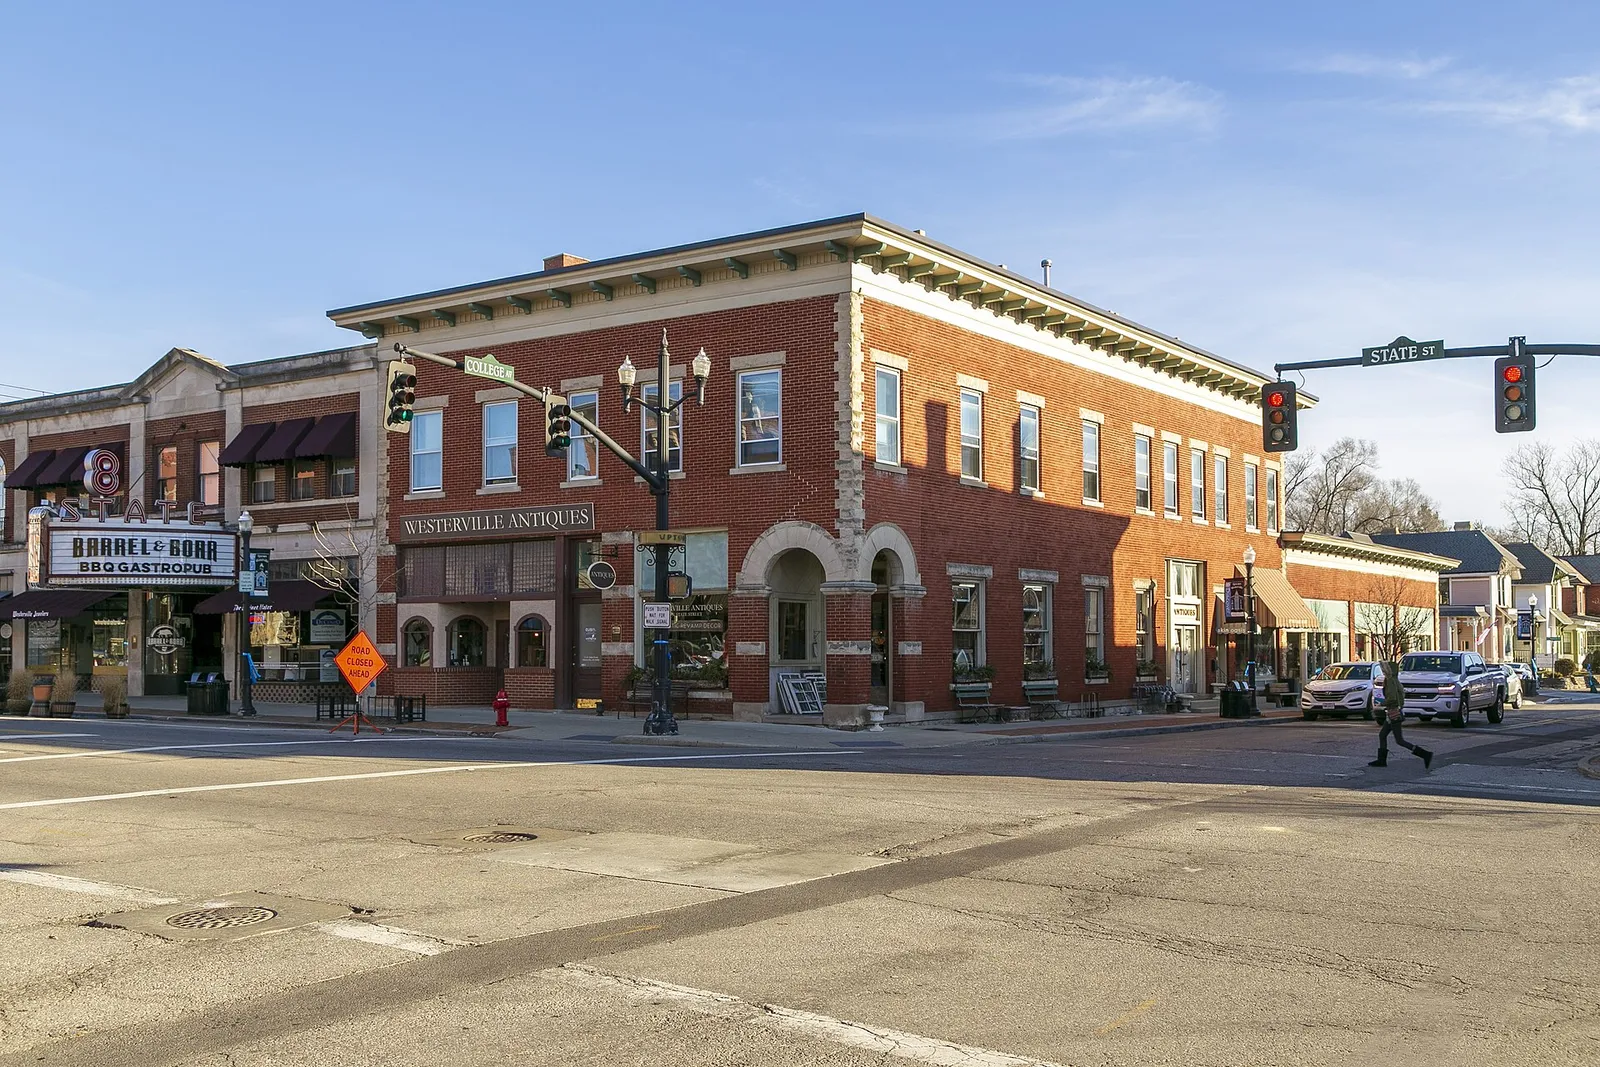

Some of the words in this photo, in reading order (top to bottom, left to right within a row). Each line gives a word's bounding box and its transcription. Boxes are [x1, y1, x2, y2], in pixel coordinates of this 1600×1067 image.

[1371, 346, 1418, 363] STATE
[1422, 346, 1435, 356] ST
[466, 360, 505, 378] COLLEGE
[84, 449, 120, 495] 8
[60, 498, 207, 525] STATE
[404, 514, 505, 535] WESTERVILLE
[508, 508, 589, 530] ANTIQUES
[73, 537, 150, 558] BARREL
[153, 540, 166, 552] &
[169, 539, 218, 562] BOAR
[80, 561, 114, 573] BBQ
[118, 562, 212, 574] GASTROPUB
[590, 571, 614, 580] ANTIQUES
[691, 603, 723, 612] ANTIQUES
[351, 645, 371, 655] ROAD
[346, 657, 374, 668] CLOSED
[348, 668, 370, 679] AHEAD
